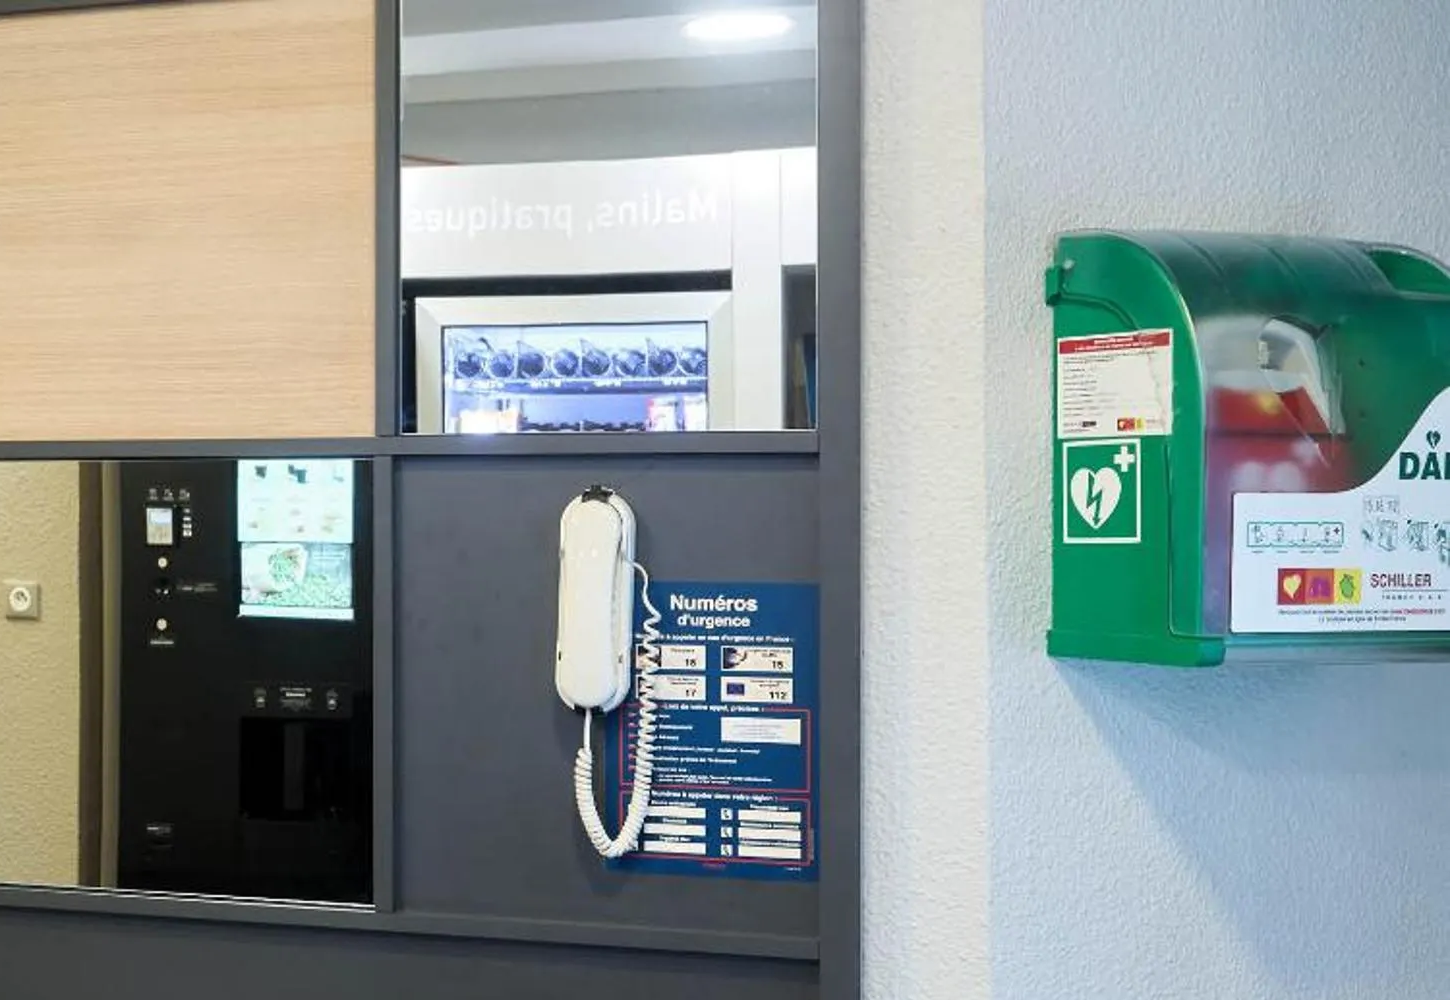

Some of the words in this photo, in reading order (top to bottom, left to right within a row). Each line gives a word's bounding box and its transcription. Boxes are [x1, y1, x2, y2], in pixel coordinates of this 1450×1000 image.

[1398, 452, 1450, 480] DA
[1370, 573, 1431, 588] SCHILLER
[670, 594, 758, 612] Numéros
[677, 614, 751, 629] d'urgence
[769, 691, 787, 700] 112
